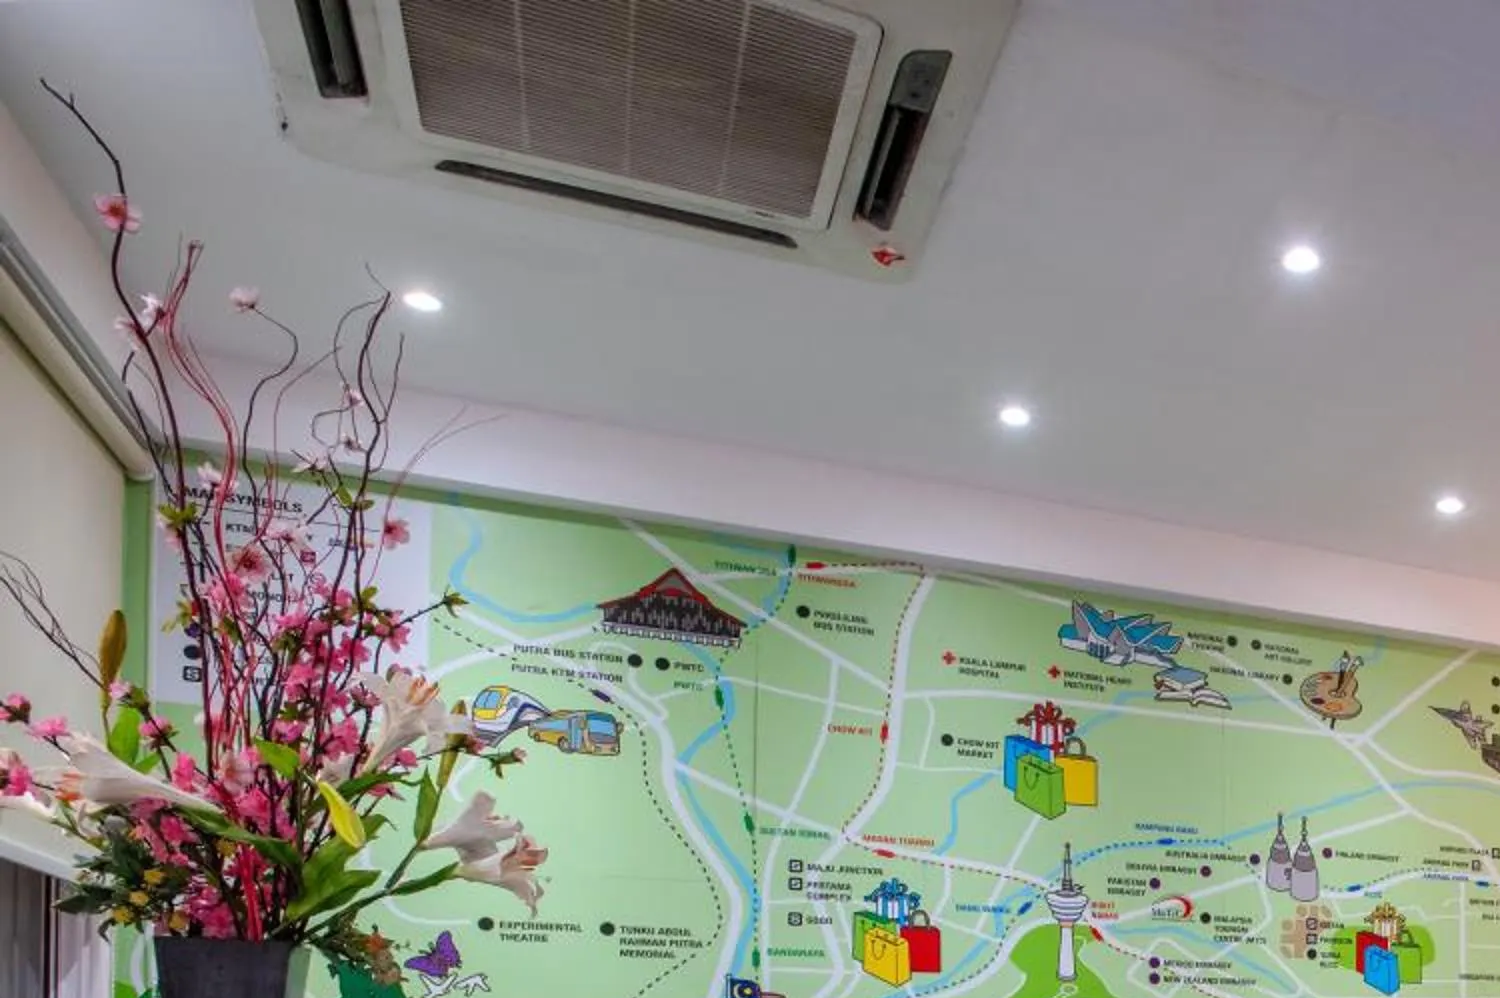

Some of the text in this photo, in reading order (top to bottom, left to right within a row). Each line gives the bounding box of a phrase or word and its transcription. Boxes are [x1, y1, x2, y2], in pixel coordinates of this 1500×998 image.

[553, 646, 576, 659] BUS
[578, 650, 624, 664] STATION
[578, 670, 624, 684] STATION
[499, 920, 583, 935] EXPERIMENTAL
[499, 931, 549, 944] THEATRE
